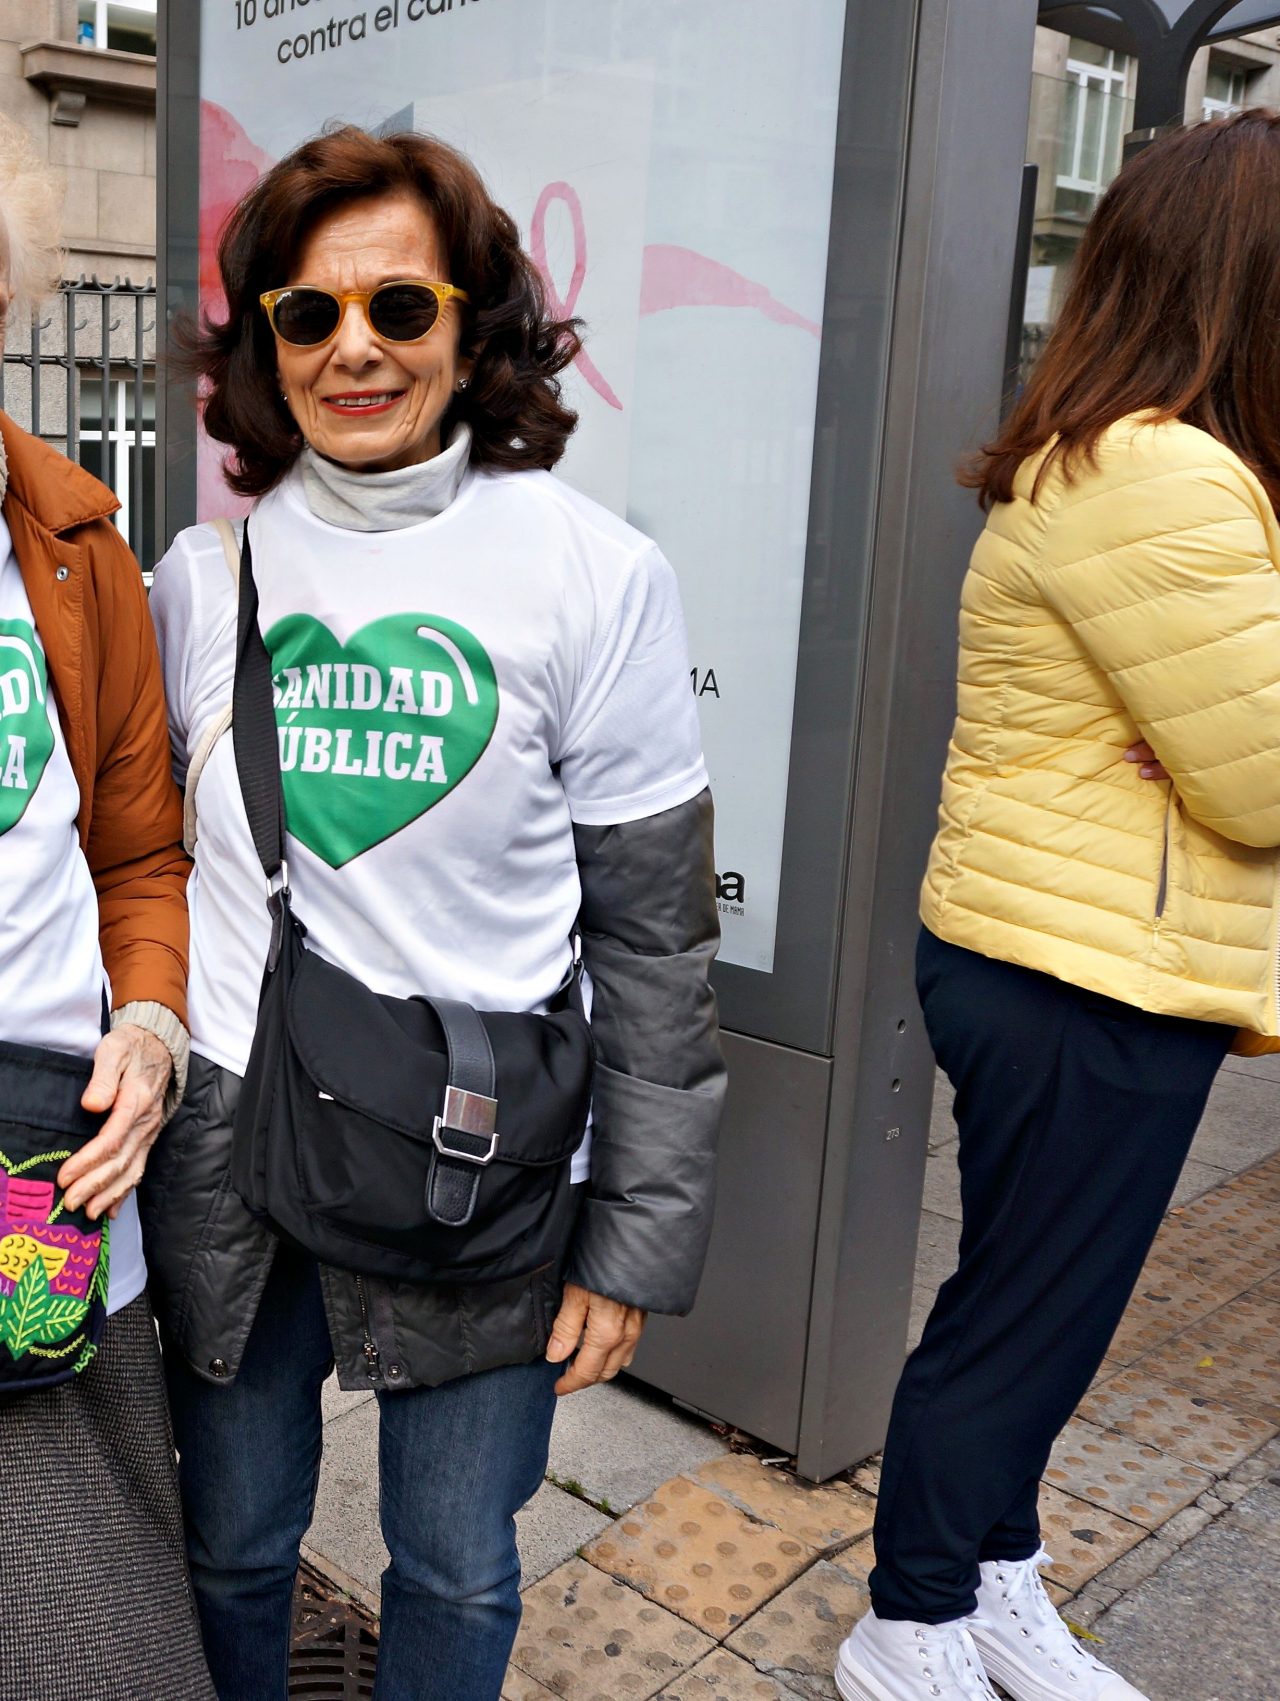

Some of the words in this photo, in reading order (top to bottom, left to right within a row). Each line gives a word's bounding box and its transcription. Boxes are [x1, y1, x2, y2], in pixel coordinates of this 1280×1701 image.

[235, 0, 257, 30] 10
[277, 12, 367, 64] contra
[374, 0, 399, 32] el
[277, 711, 448, 784] ÚBLICA
